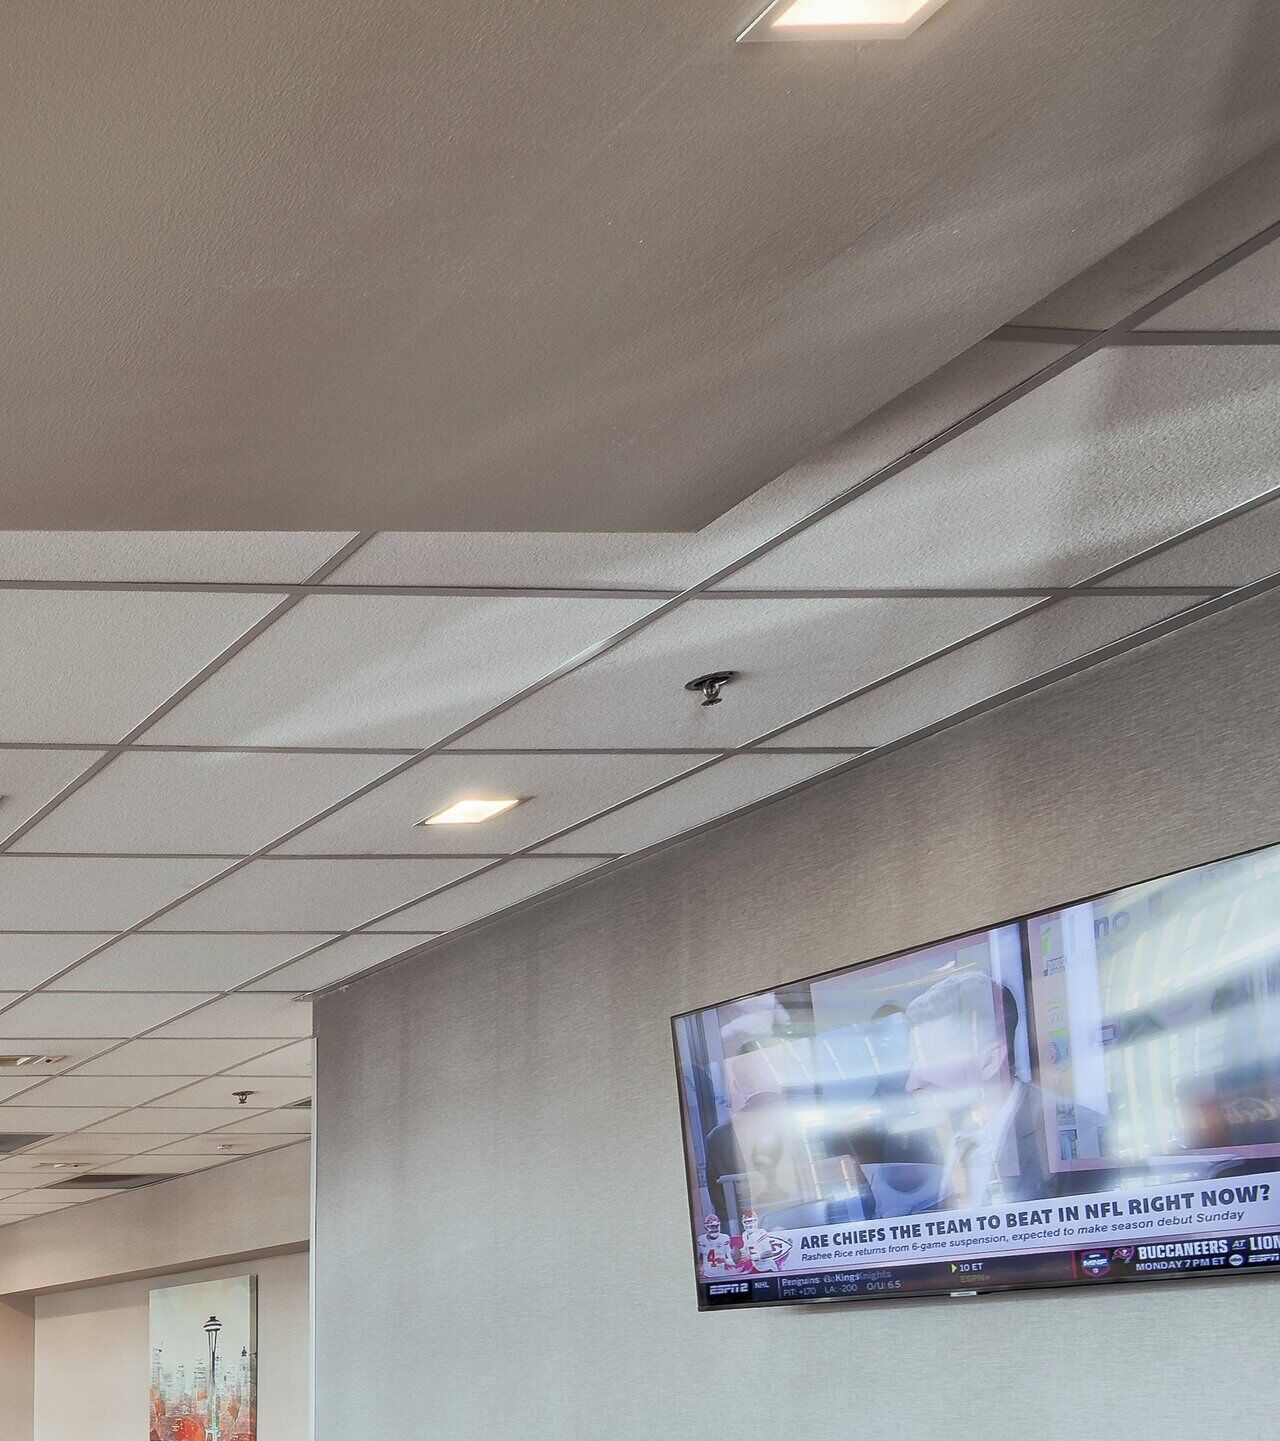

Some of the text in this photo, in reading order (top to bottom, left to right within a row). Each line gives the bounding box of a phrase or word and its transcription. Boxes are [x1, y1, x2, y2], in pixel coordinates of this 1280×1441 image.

[800, 1184, 1270, 1250] ARE CHIEFS THE TEAM TO BEAT IN NFL RIGHT NOW?
[801, 1210, 1246, 1262] Rashee Rice returns from 6-game suspension, expected to make season debut Sunday
[1137, 1239, 1229, 1260] BUCCANEERS
[1231, 1239, 1247, 1248] AT
[959, 1262, 984, 1272] 10 ET
[1135, 1260, 1182, 1272] MONDAY
[1184, 1260, 1191, 1268] 7
[1192, 1258, 1210, 1267] PM
[1212, 1256, 1226, 1265] ET
[754, 1281, 770, 1289] NHL
